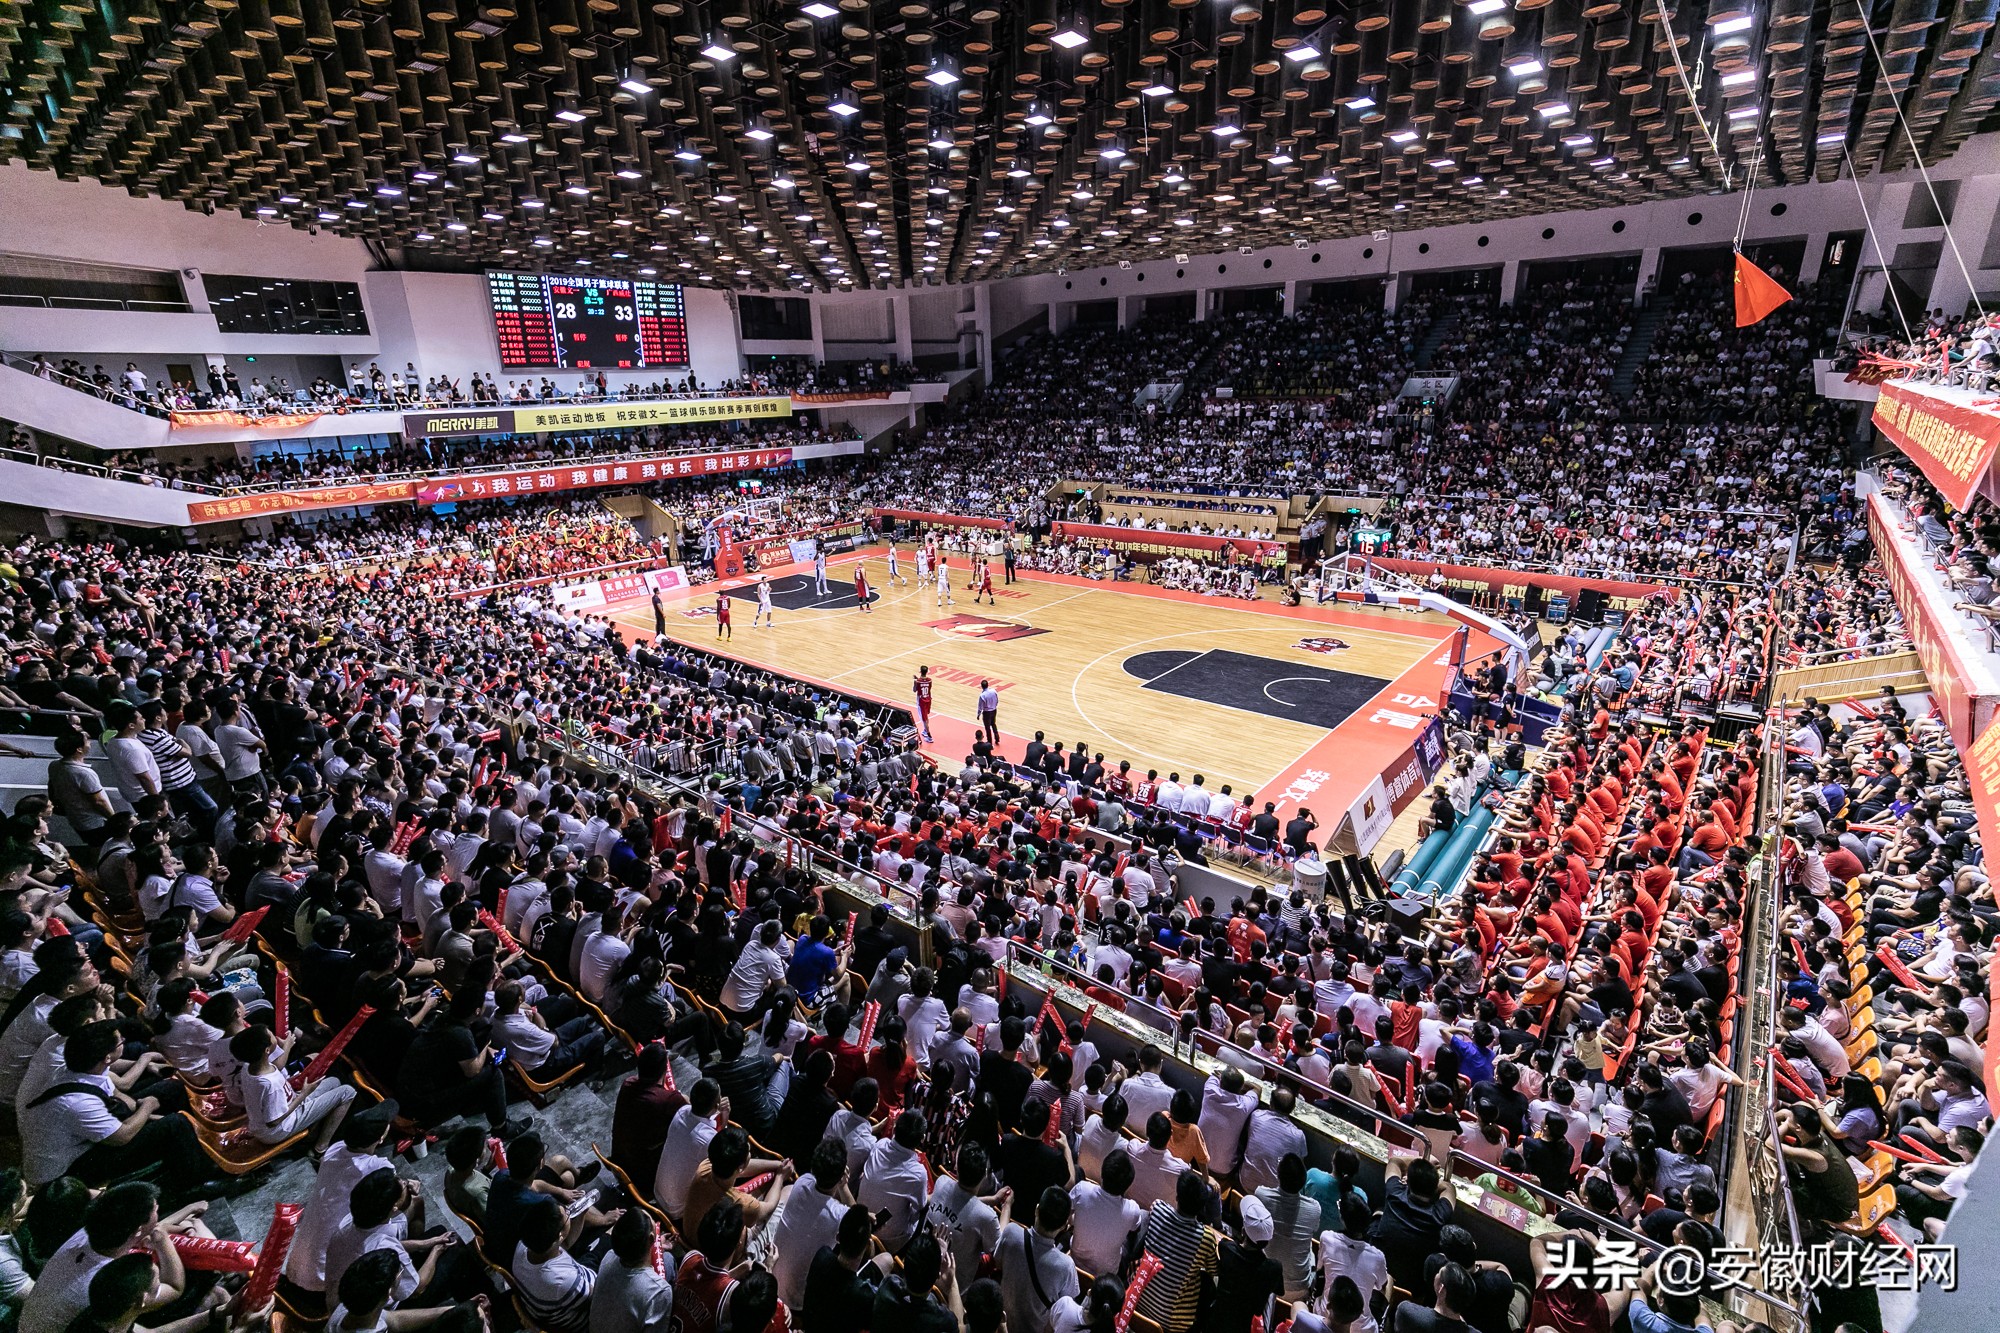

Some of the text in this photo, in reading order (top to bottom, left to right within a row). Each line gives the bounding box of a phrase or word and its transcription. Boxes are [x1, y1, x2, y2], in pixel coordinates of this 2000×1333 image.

[549, 277, 630, 290] 2019全国男子篮球联赛
[586, 289, 598, 297] VS
[555, 303, 577, 319] 28
[614, 306, 634, 320] 33
[536, 402, 778, 426] 美凯运动地板 祝安徽文一篮球俱乐部新赛季再创辉煌
[426, 417, 474, 433] MERRY
[492, 452, 750, 495] 我运动 我健康 我快乐 我出彩
[259, 493, 305, 510] 不忘初心
[1359, 541, 1374, 555] 16
[1138, 785, 1150, 798] 26
